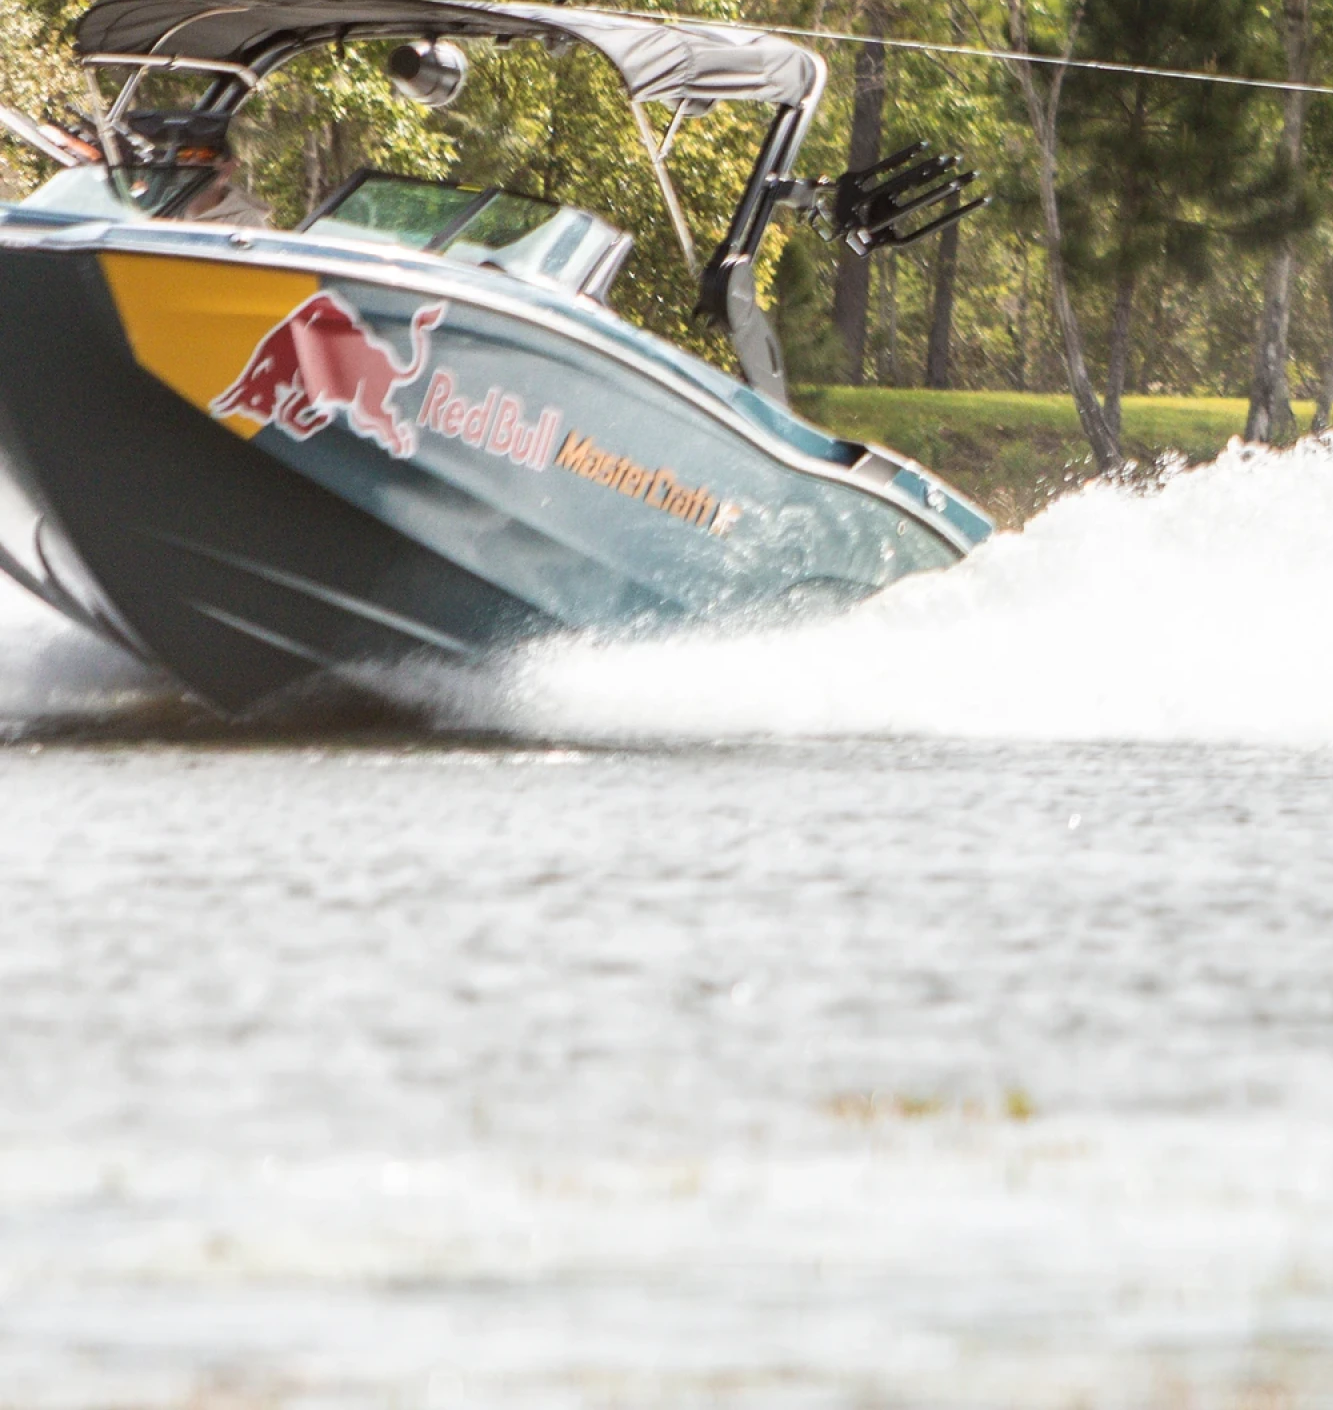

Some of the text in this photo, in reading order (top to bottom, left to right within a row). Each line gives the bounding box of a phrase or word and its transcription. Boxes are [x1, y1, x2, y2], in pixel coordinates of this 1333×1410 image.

[417, 368, 562, 472] Red Bull
[554, 428, 717, 527] MasterCraft
